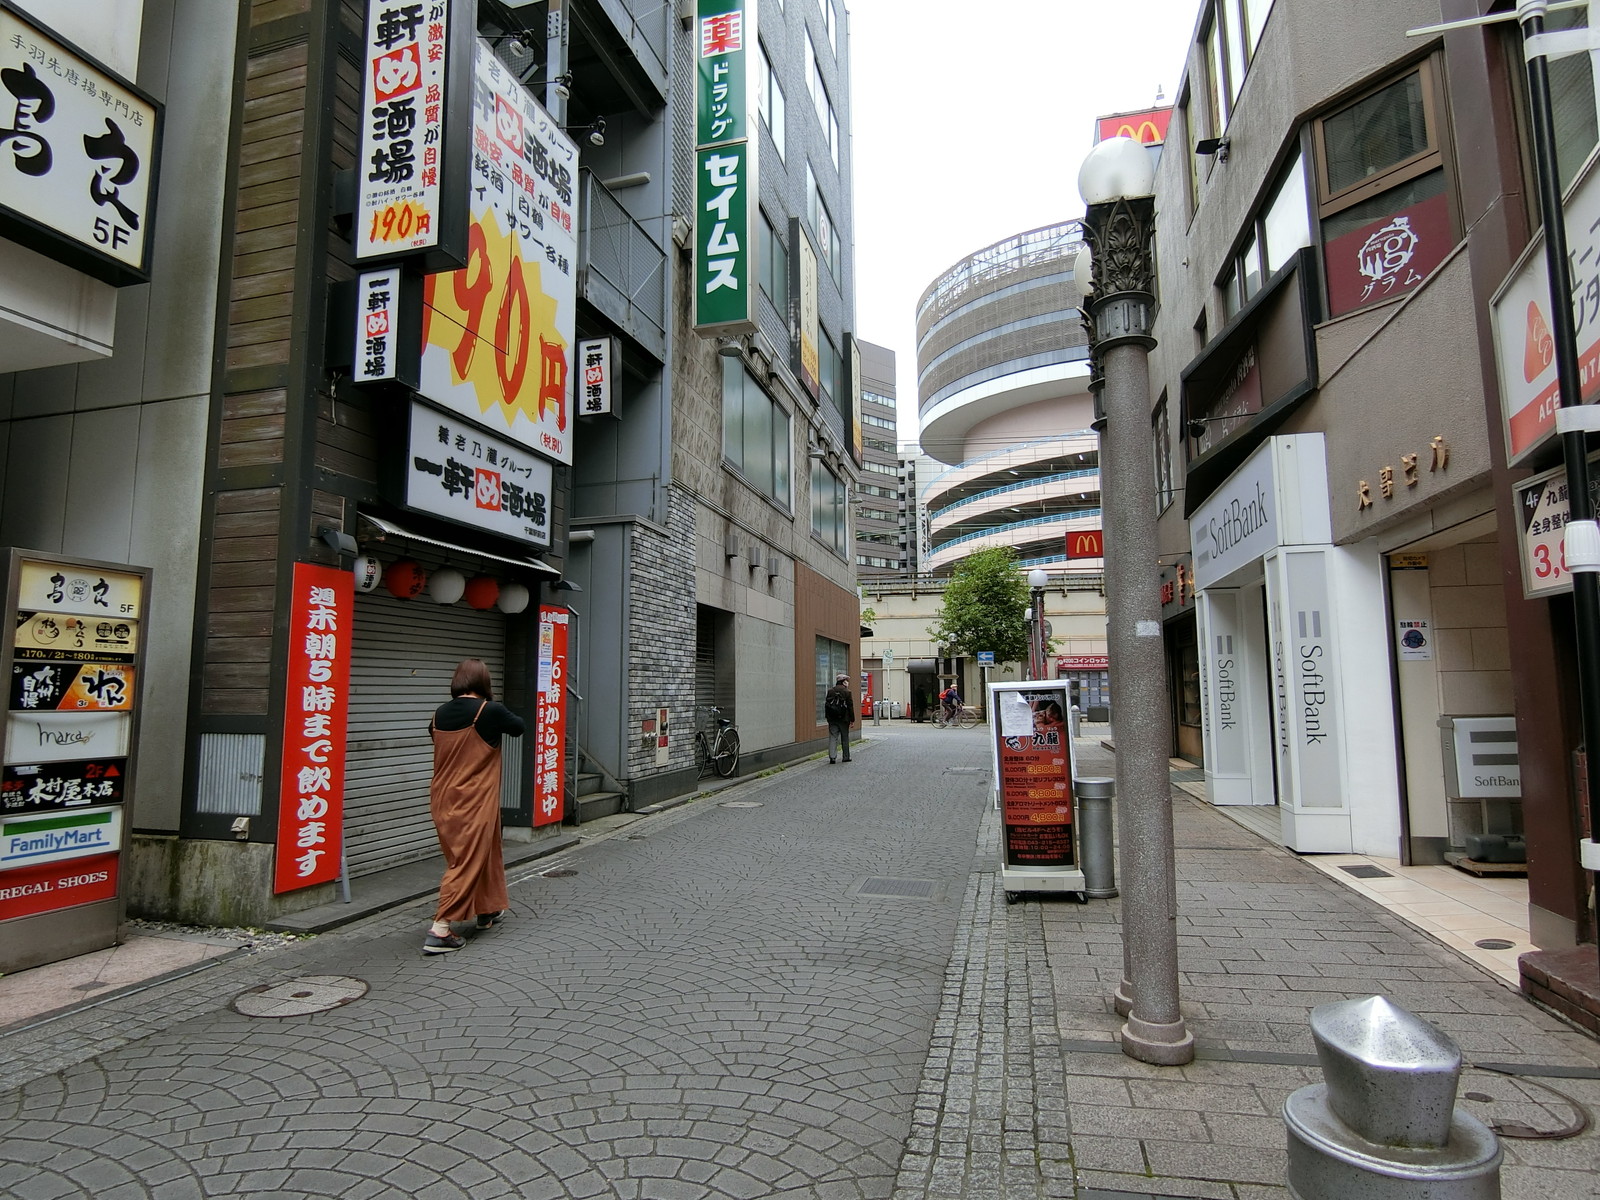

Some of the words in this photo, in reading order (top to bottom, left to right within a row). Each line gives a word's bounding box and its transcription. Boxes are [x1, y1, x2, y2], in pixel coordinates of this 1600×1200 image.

[703, 14, 740, 56] 薬
[9, 33, 144, 127] 手羽先唐揚専門店
[369, 0, 424, 183] 軒め酒場
[421, 0, 444, 187] が激安・品質が自慢
[711, 61, 732, 138] ドラッグ
[92, 216, 131, 250] 5F
[370, 204, 431, 243] 190円
[704, 154, 740, 294] セイムス
[1361, 268, 1422, 302] グラム
[364, 278, 390, 377] 一軒め酒場
[585, 344, 604, 412] 一軒め酒場
[438, 425, 533, 479] 養老乃瀧グループ
[539, 431, 563, 455] (税別)
[414, 457, 547, 526] 一軒め酒場
[1209, 480, 1268, 559] SoftBank
[1525, 491, 1539, 509] 4F
[119, 604, 135, 613] 5F
[1217, 659, 1236, 731] SoftBank
[1276, 640, 1290, 757] SoftBank
[1300, 645, 1327, 746] SoftBank
[294, 585, 338, 877] 週末朝5時まで飲めます
[1032, 732, 1059, 746] 九龍
[26, 777, 114, 804] 木村屋本店
[10, 828, 102, 853] FamilyMart
[0, 881, 54, 900] REGAL
[58, 871, 108, 889] SHOES
